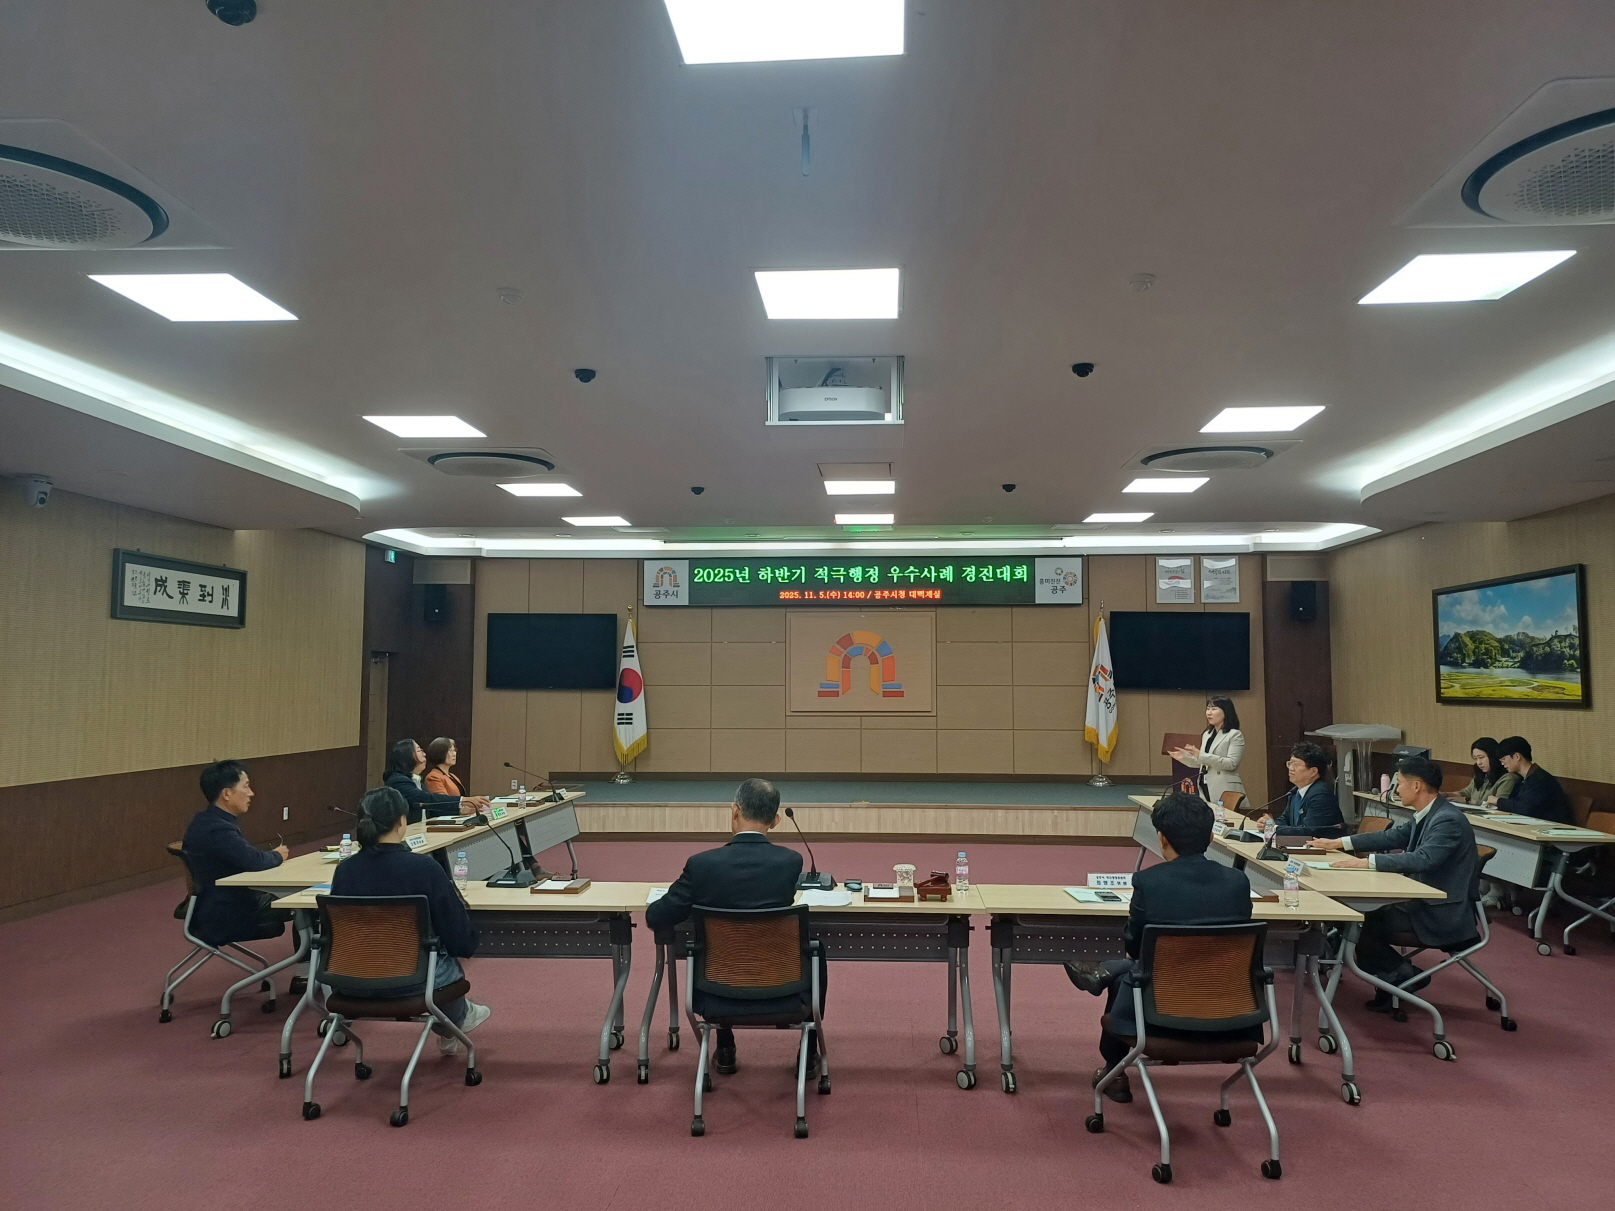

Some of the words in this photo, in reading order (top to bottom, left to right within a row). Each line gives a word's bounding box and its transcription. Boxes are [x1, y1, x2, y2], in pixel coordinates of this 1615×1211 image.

[693, 567, 751, 583] 2025년
[757, 566, 806, 584] 하반기
[814, 565, 880, 584] 적극행정
[886, 565, 954, 583] 우수사례
[961, 565, 1028, 583] 경진대회
[653, 589, 679, 600] 공주시
[779, 590, 802, 600] 2025.
[804, 590, 817, 600] 11.
[818, 590, 840, 600] 5.(수)
[874, 589, 906, 600] 공주시청
[1050, 585, 1067, 595] 공주
